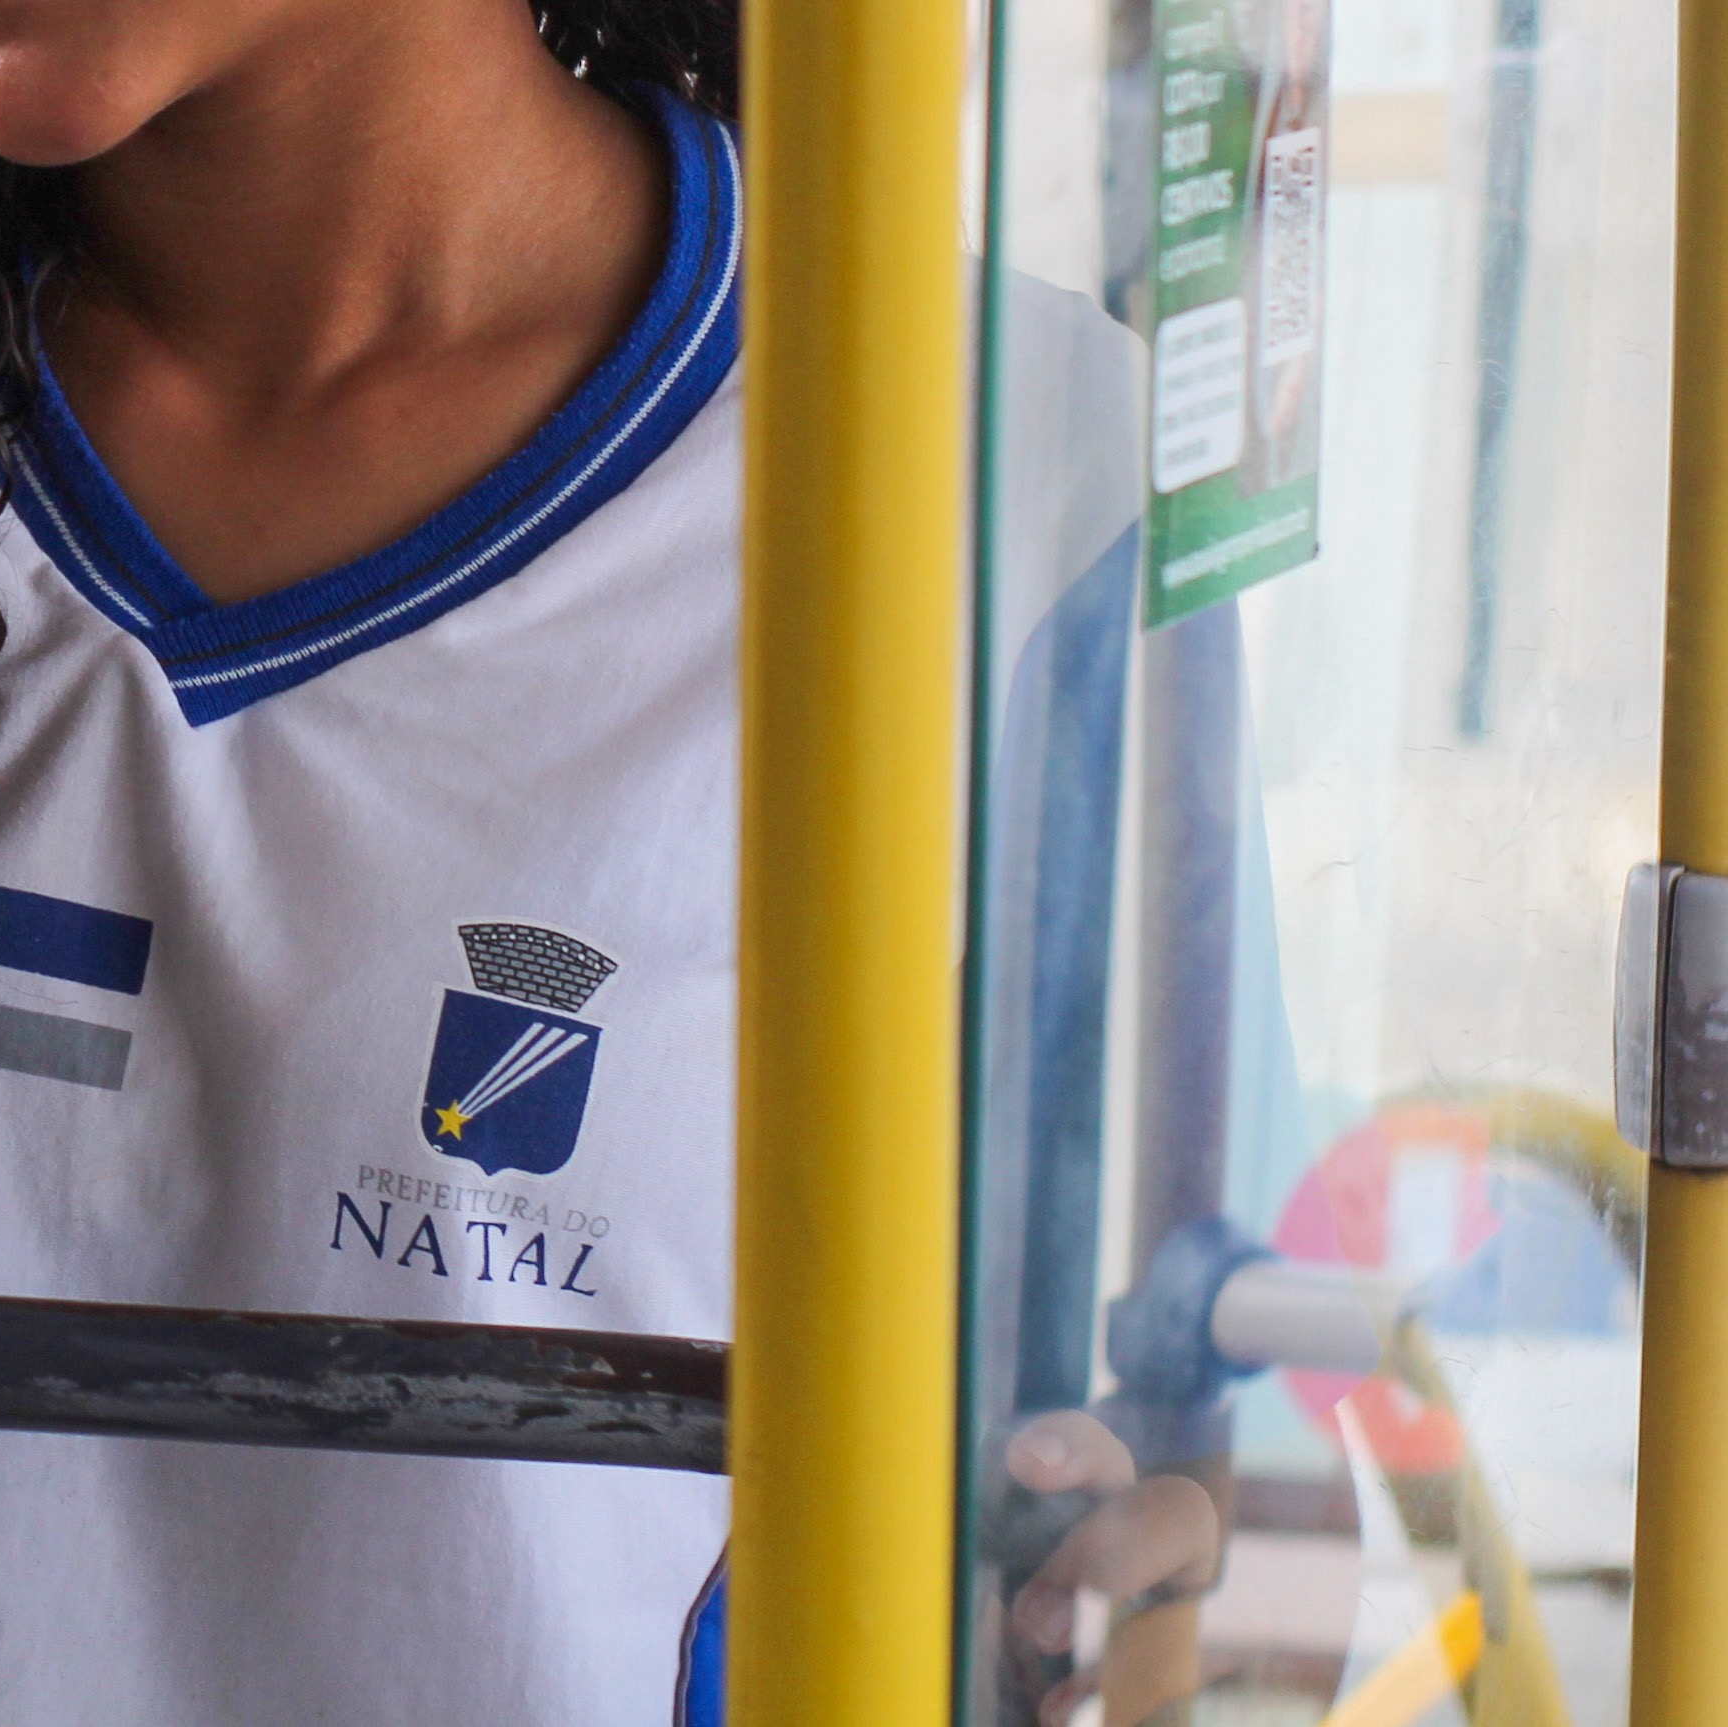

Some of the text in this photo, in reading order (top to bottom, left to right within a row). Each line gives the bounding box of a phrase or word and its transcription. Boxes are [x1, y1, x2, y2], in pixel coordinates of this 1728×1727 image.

[330, 1191, 597, 1297] NATAL
[357, 1164, 611, 1239] PREFEITURA DO
